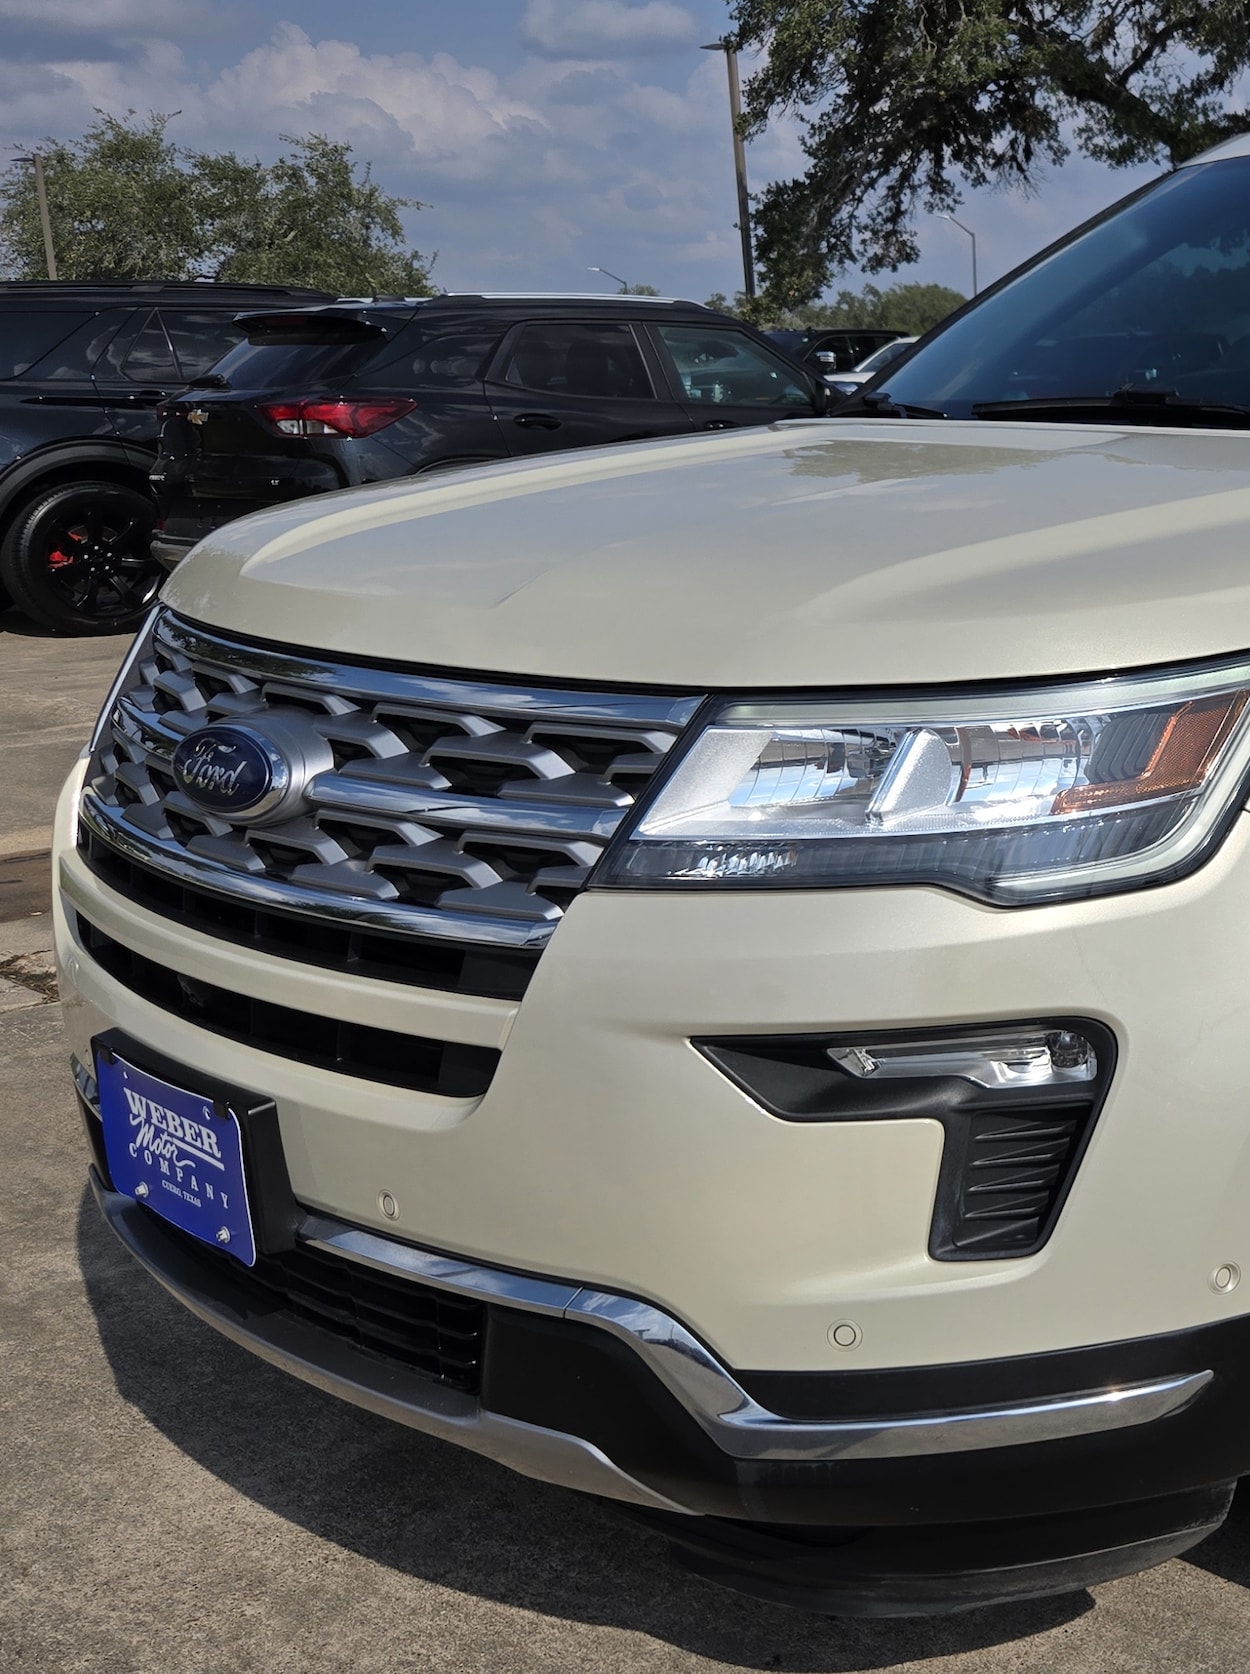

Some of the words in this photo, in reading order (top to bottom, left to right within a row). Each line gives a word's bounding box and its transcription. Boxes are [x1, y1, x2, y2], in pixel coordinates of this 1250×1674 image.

[182, 737, 248, 796] Ford
[123, 1086, 222, 1159] WEBER
[129, 1113, 196, 1168] Motor
[129, 1142, 229, 1209] COMPANY
[182, 1190, 202, 1208] TEXAS
